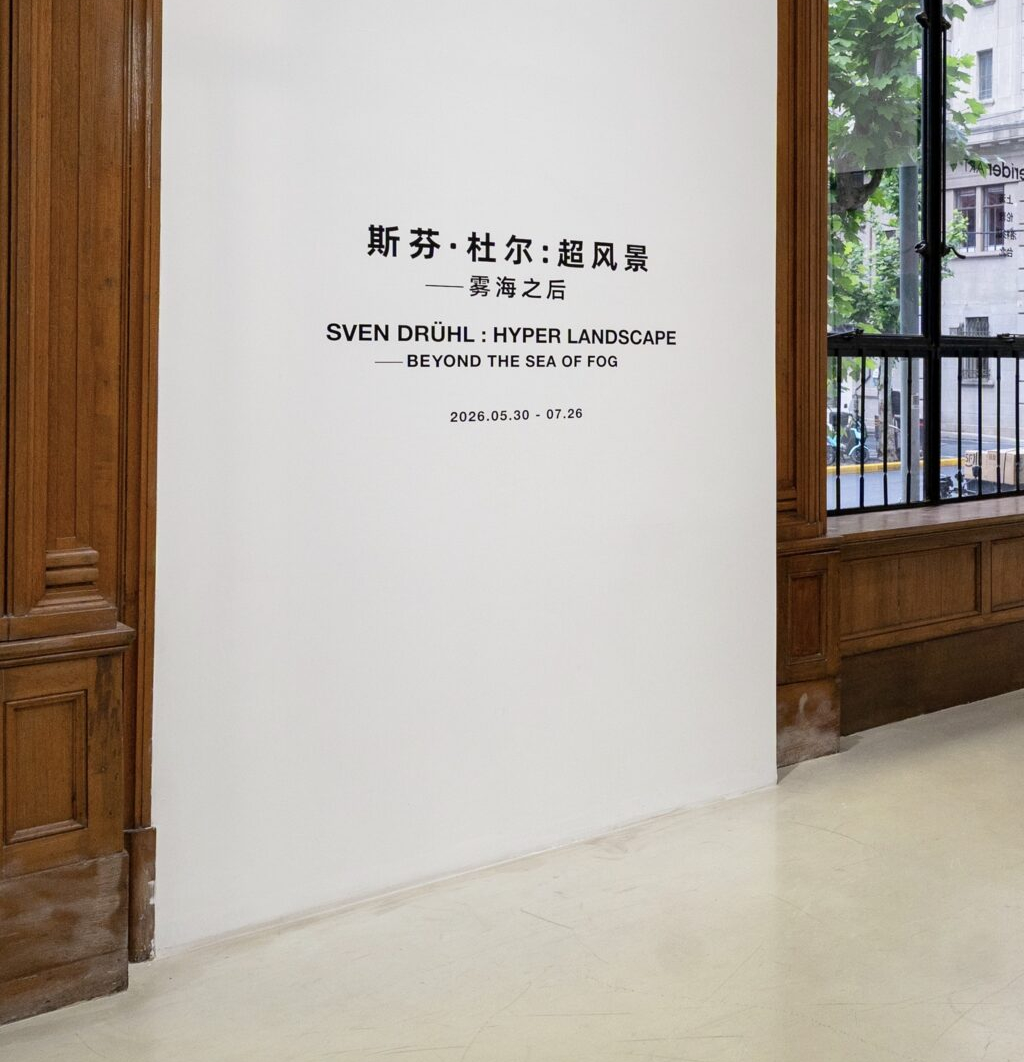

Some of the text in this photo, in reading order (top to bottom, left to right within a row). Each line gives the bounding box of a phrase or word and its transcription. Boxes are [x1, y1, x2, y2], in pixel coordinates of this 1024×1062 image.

[326, 322, 389, 342] SVEN
[397, 321, 475, 343] DRÜHL
[493, 326, 561, 344] HYPER
[567, 328, 677, 346] LANDSCAPE
[487, 354, 520, 368] THE
[525, 354, 557, 368] SEA
[561, 354, 582, 368] OF
[587, 354, 618, 368] FOG
[450, 409, 530, 423] 2026.05.30
[546, 408, 583, 421] 07.26
